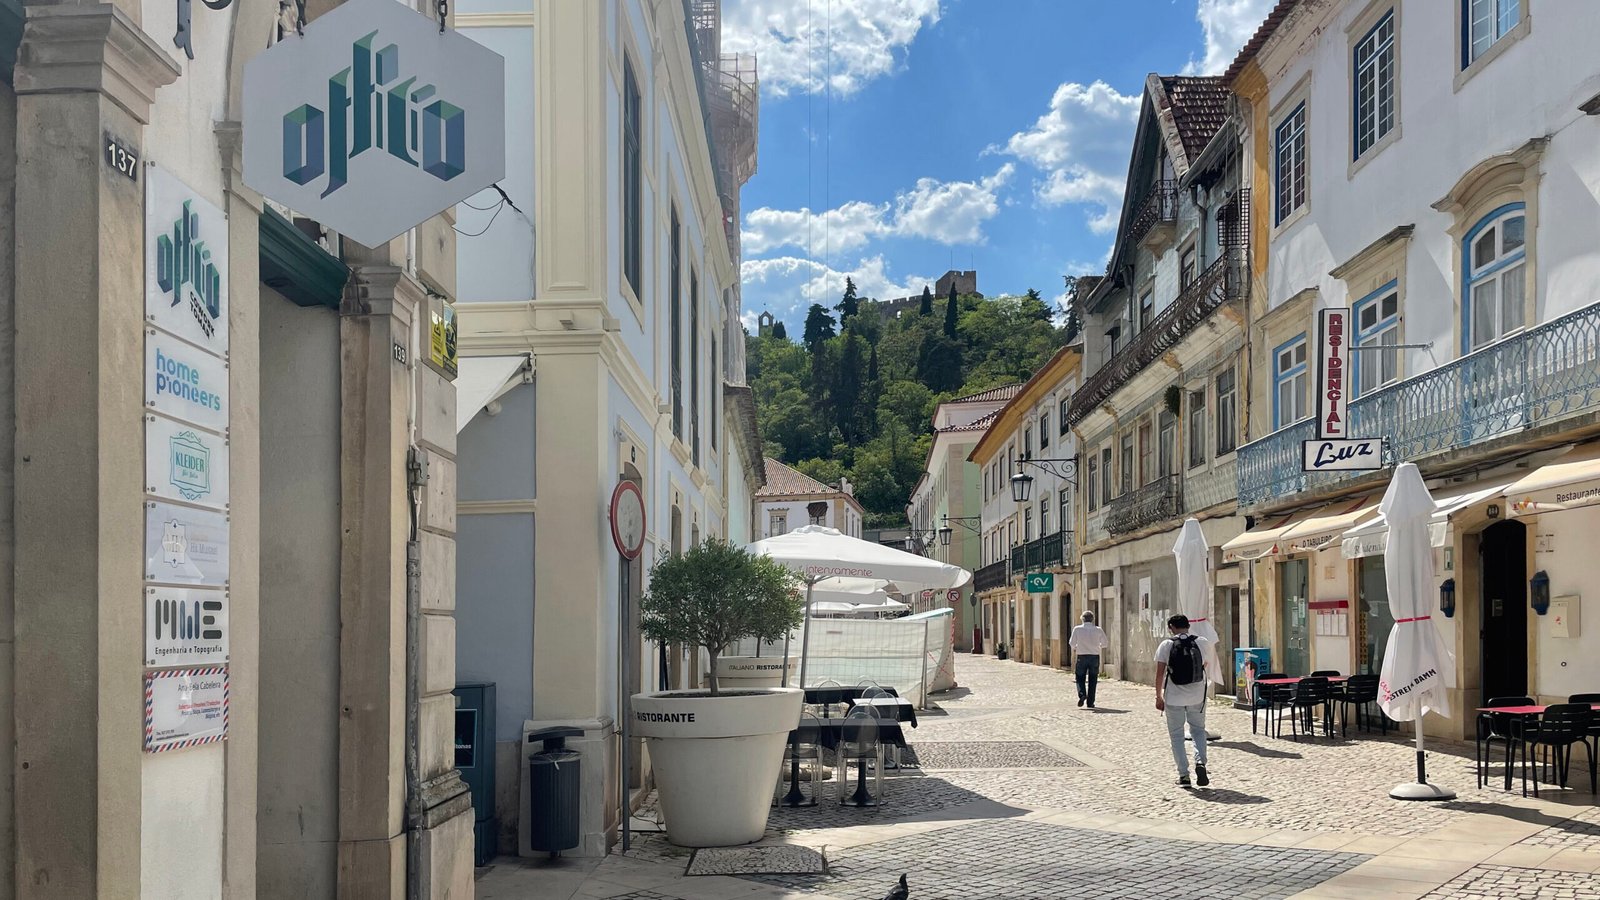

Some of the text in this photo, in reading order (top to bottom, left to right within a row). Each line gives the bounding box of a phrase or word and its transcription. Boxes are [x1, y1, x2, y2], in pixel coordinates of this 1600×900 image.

[108, 143, 136, 177] 137
[189, 291, 215, 337] COWORK
[190, 300, 210, 339] TOMAR
[156, 348, 199, 385] home
[394, 344, 406, 363] 139
[1326, 313, 1343, 434] RESIDENCIAL
[156, 372, 221, 411] pioneers
[175, 451, 205, 473] KLEIDER
[1313, 442, 1374, 468] Luz
[155, 599, 223, 640] MWE
[155, 646, 187, 656] Engenharia
[194, 644, 222, 654] Topografia
[1414, 668, 1437, 685] DAMM
[637, 711, 696, 723] RISTORANTE
